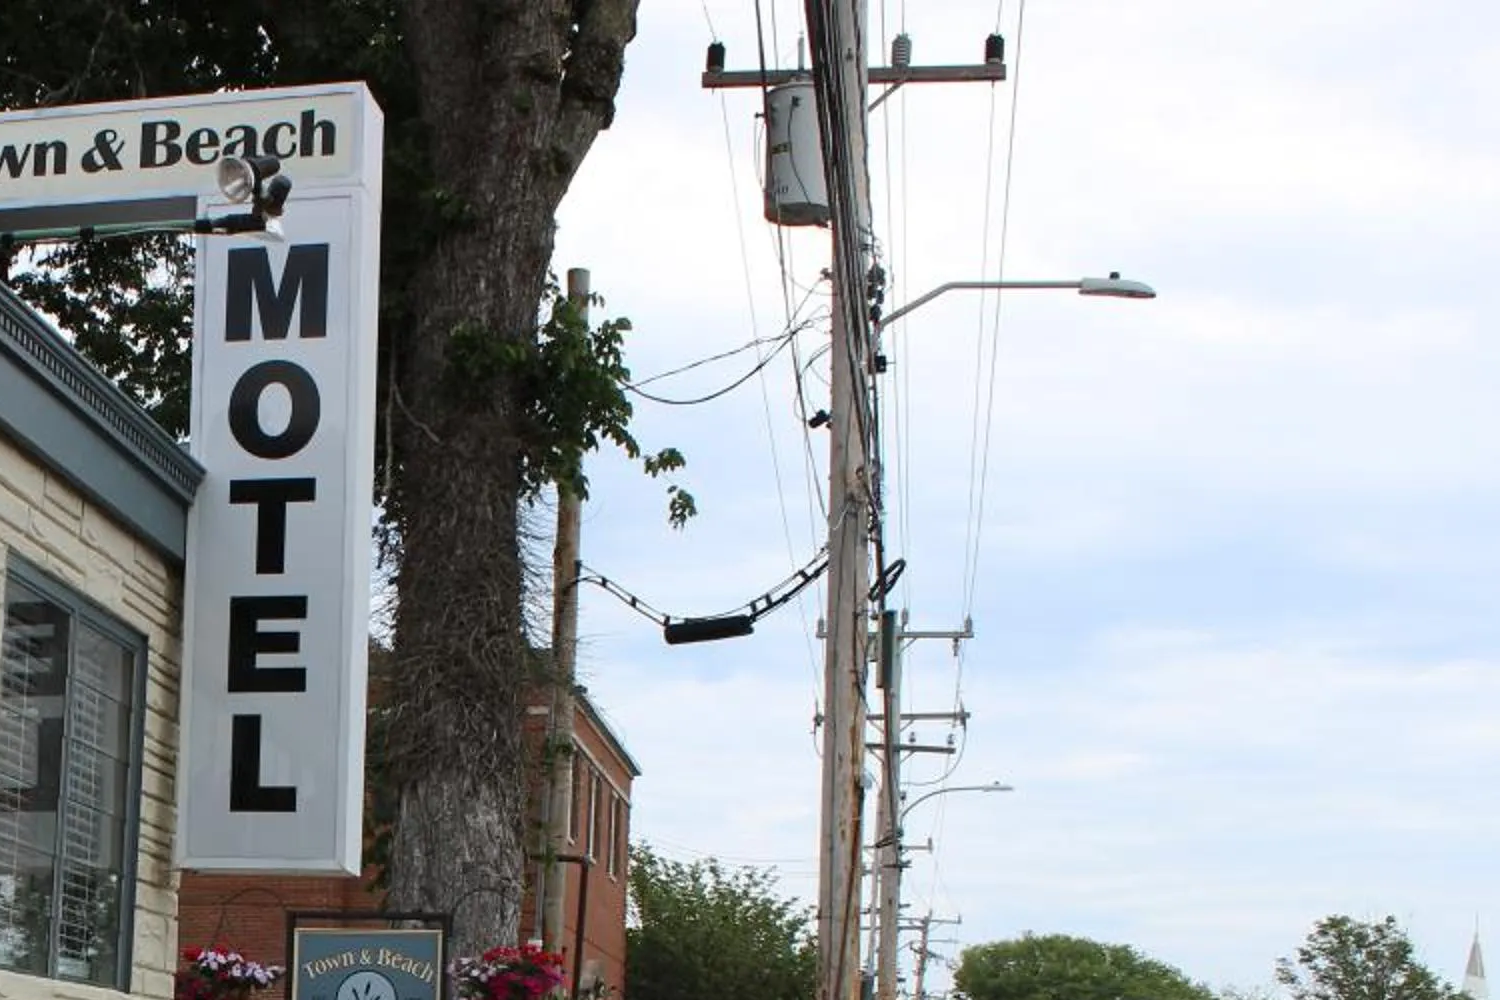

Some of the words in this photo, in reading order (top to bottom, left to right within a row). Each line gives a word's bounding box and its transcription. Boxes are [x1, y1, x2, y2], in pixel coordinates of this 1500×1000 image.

[80, 128, 125, 173] &
[139, 109, 336, 169] Beach
[224, 242, 330, 814] MOTEL
[304, 951, 354, 979] Town
[360, 949, 372, 965] &
[378, 948, 434, 983] Beach
